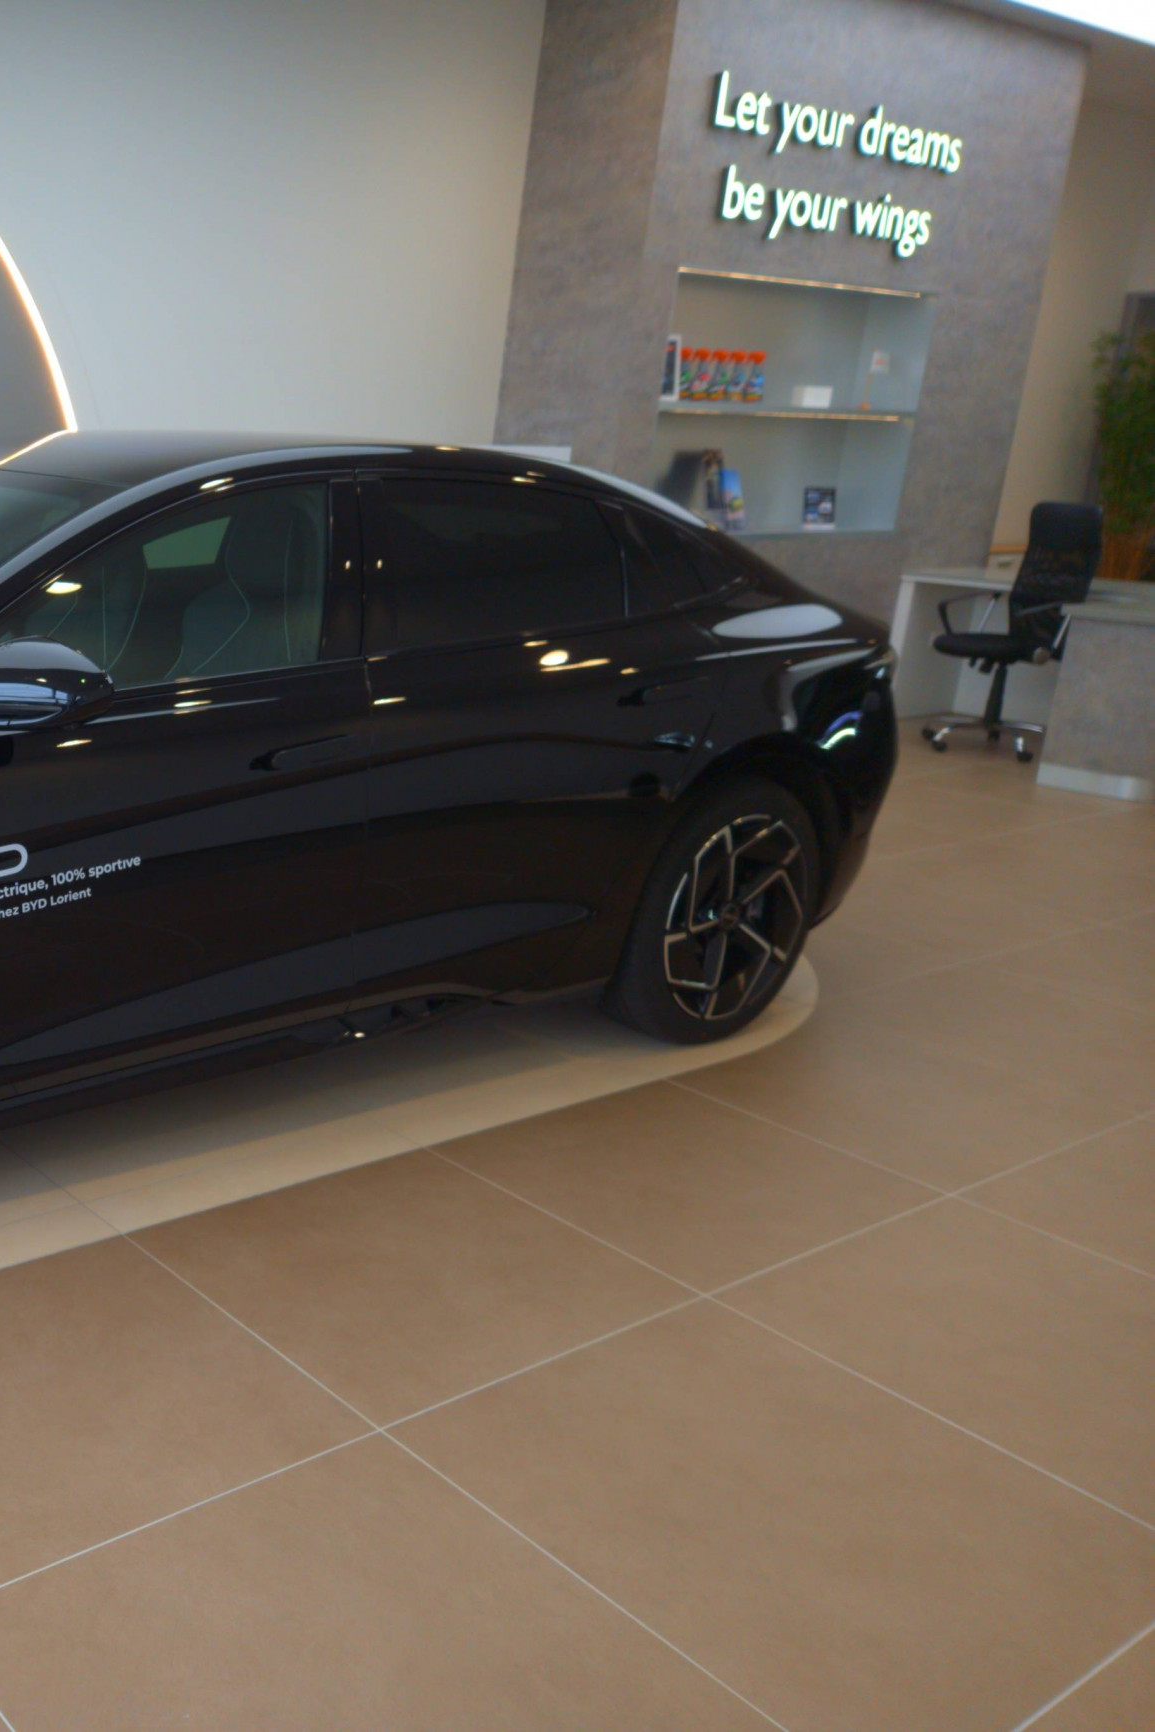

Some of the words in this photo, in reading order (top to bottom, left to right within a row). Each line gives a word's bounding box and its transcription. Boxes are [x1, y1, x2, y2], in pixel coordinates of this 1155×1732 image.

[713, 70, 772, 136] Let
[774, 101, 855, 154] your
[858, 104, 963, 173] dreams
[721, 164, 766, 221] be
[767, 188, 848, 240] your
[853, 193, 932, 258] wings
[21, 898, 48, 914] BYD
[50, 887, 93, 907] Lorient
[50, 867, 86, 886] 100%
[88, 856, 142, 878] sportive
